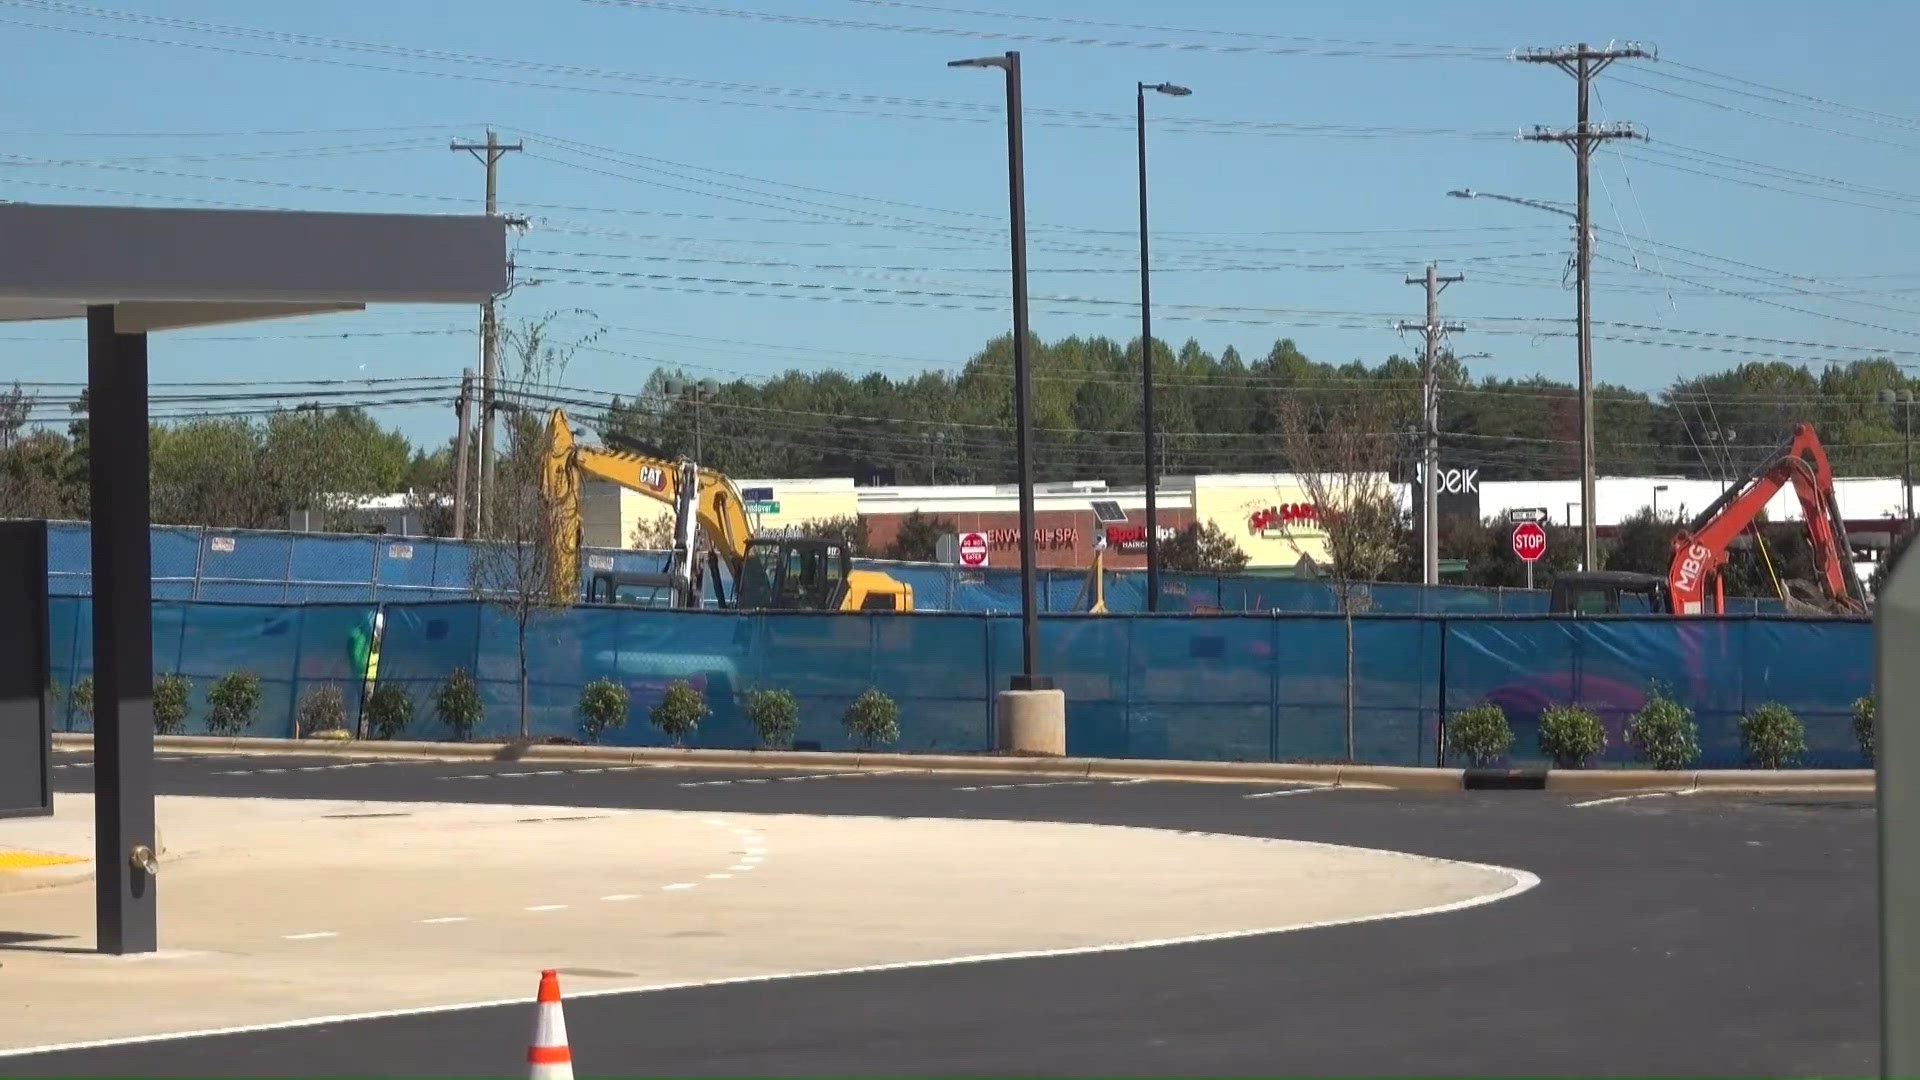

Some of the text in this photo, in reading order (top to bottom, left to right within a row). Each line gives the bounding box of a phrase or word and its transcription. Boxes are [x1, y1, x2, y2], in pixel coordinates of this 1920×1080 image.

[640, 466, 662, 486] CAT
[987, 528, 1079, 543] ENVY AIL SPA
[1516, 534, 1543, 549] STOP
[1674, 544, 1706, 592] MBG
